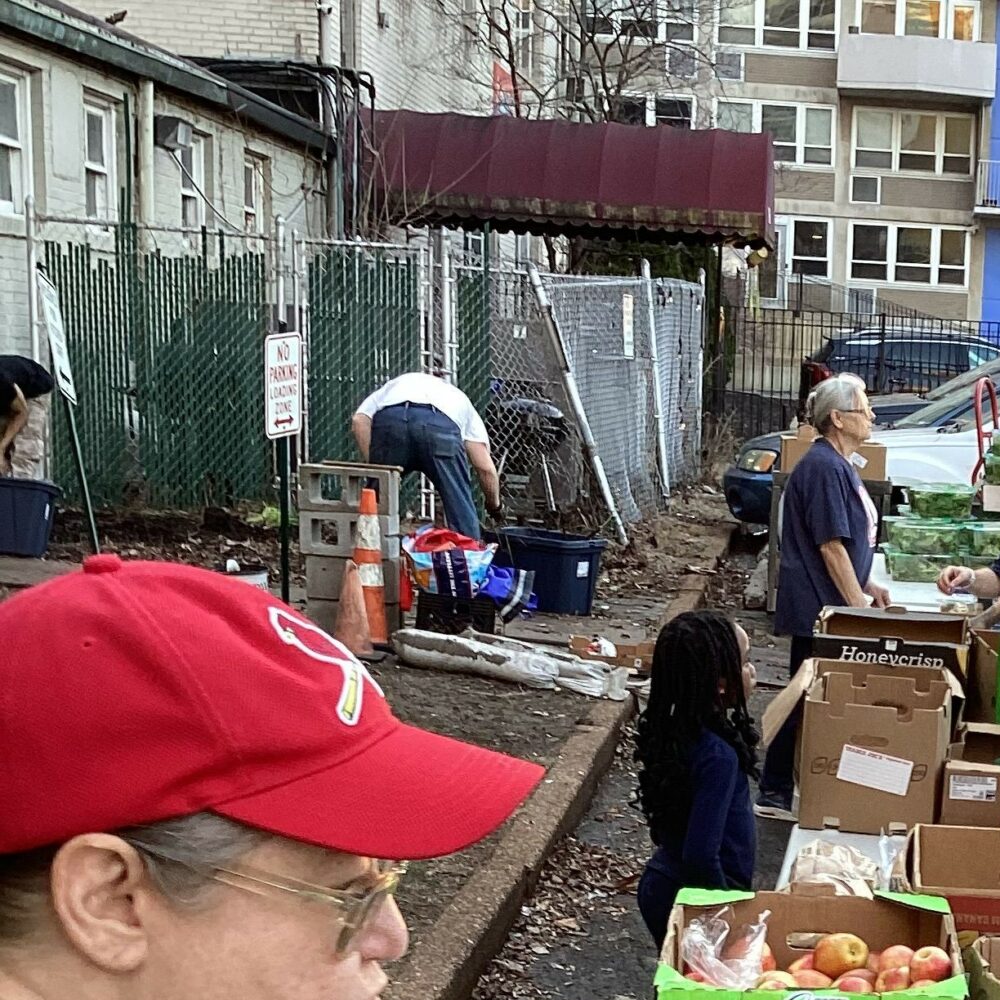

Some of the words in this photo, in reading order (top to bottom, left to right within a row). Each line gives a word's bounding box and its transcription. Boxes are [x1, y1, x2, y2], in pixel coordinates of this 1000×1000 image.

[277, 344, 290, 361] NO
[270, 363, 297, 382] PARKING
[270, 384, 297, 399] LOADING
[275, 400, 292, 415] ZONE
[839, 645, 944, 668] Honeycrisp
[956, 913, 990, 925] BANAN
